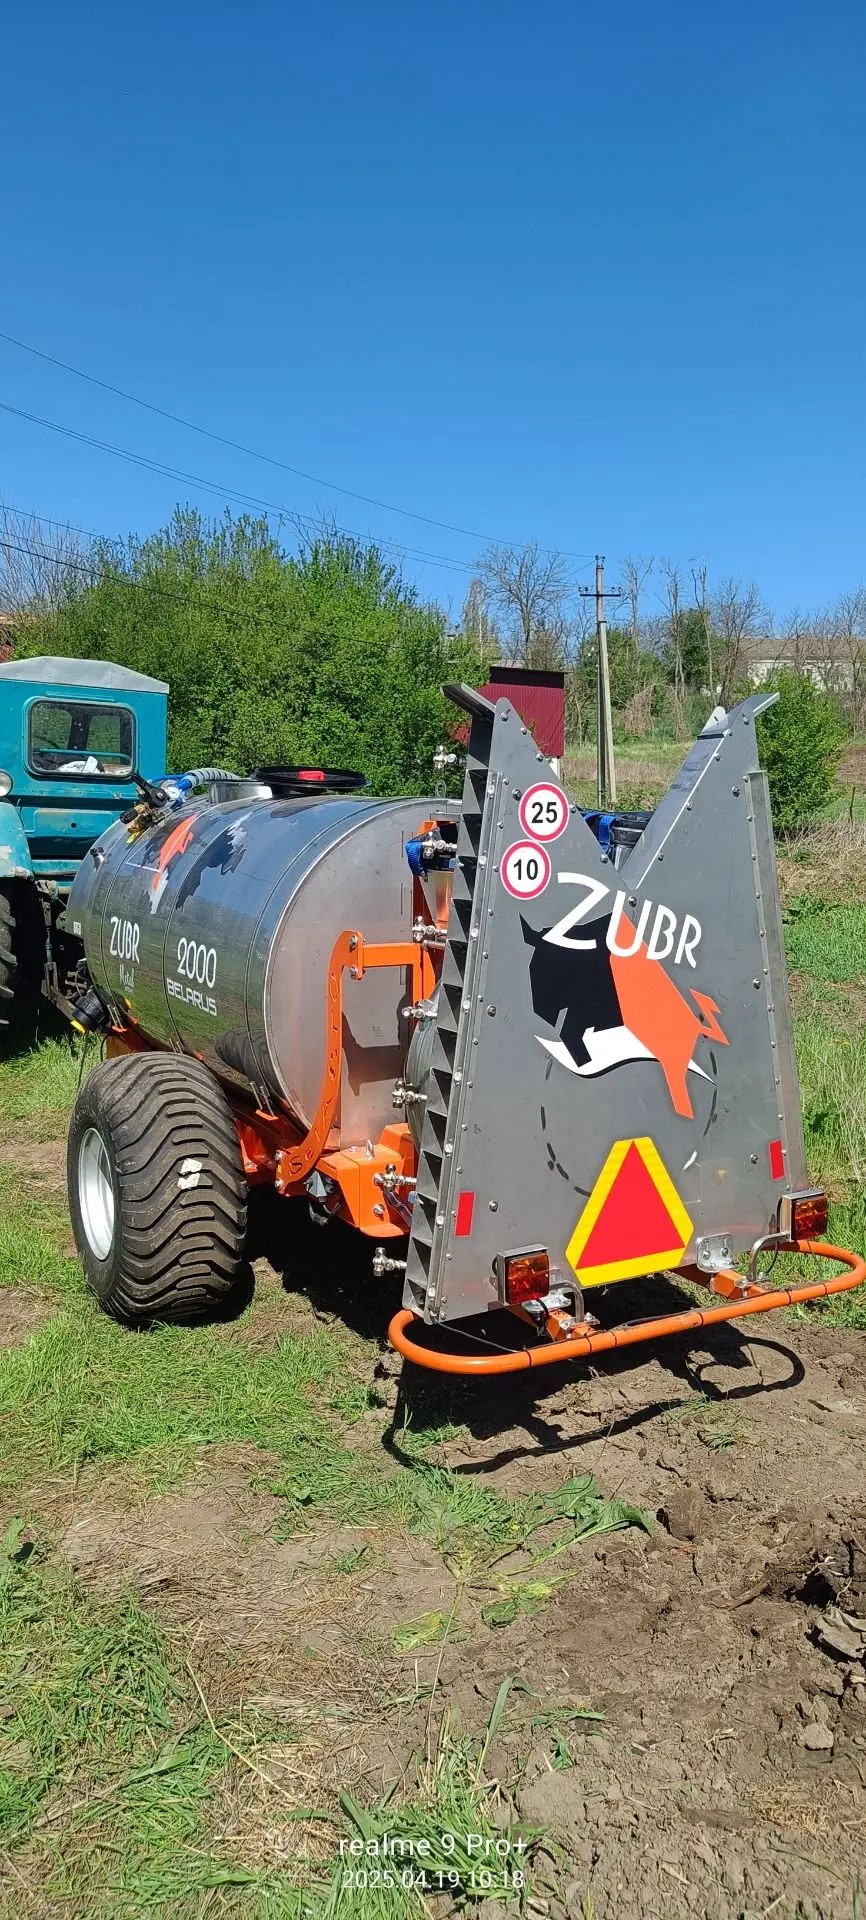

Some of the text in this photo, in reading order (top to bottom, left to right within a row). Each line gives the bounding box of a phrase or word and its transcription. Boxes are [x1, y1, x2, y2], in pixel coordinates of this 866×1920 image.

[531, 801, 558, 824] 25
[513, 858, 539, 881] 10
[110, 916, 140, 964] ZUBR
[541, 871, 702, 969] ZUBR
[177, 937, 217, 989] 2000
[166, 977, 217, 1016] BELARUS
